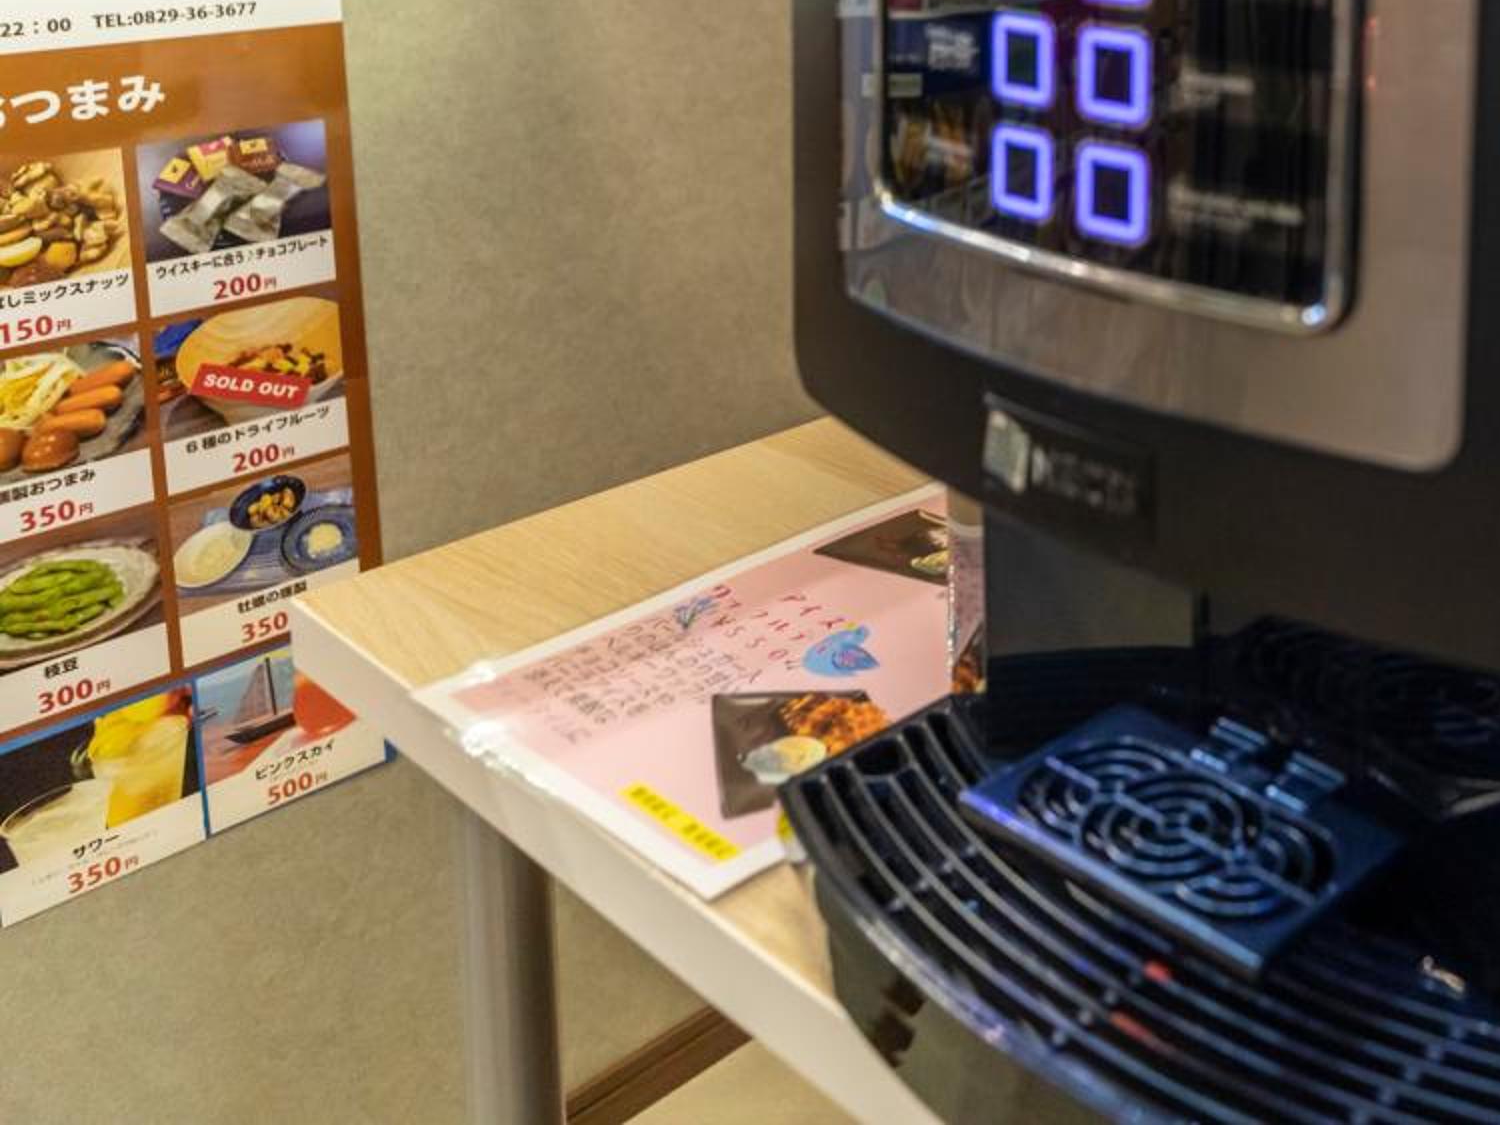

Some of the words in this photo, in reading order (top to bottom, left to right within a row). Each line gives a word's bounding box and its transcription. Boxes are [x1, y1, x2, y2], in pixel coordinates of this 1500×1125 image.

[93, 1, 257, 29] TEL:0829-36-3677
[0, 75, 165, 129] つまみ
[213, 273, 277, 300] 200円
[0, 315, 71, 345] 150円
[203, 373, 254, 393] SOLD
[258, 382, 299, 398] OUT
[233, 444, 295, 473] 200円
[20, 500, 94, 533] 350円
[242, 611, 288, 644] 350
[38, 678, 111, 714] 300円
[268, 771, 328, 806] 500円
[73, 834, 120, 860] サワー
[67, 856, 139, 895] 350円
